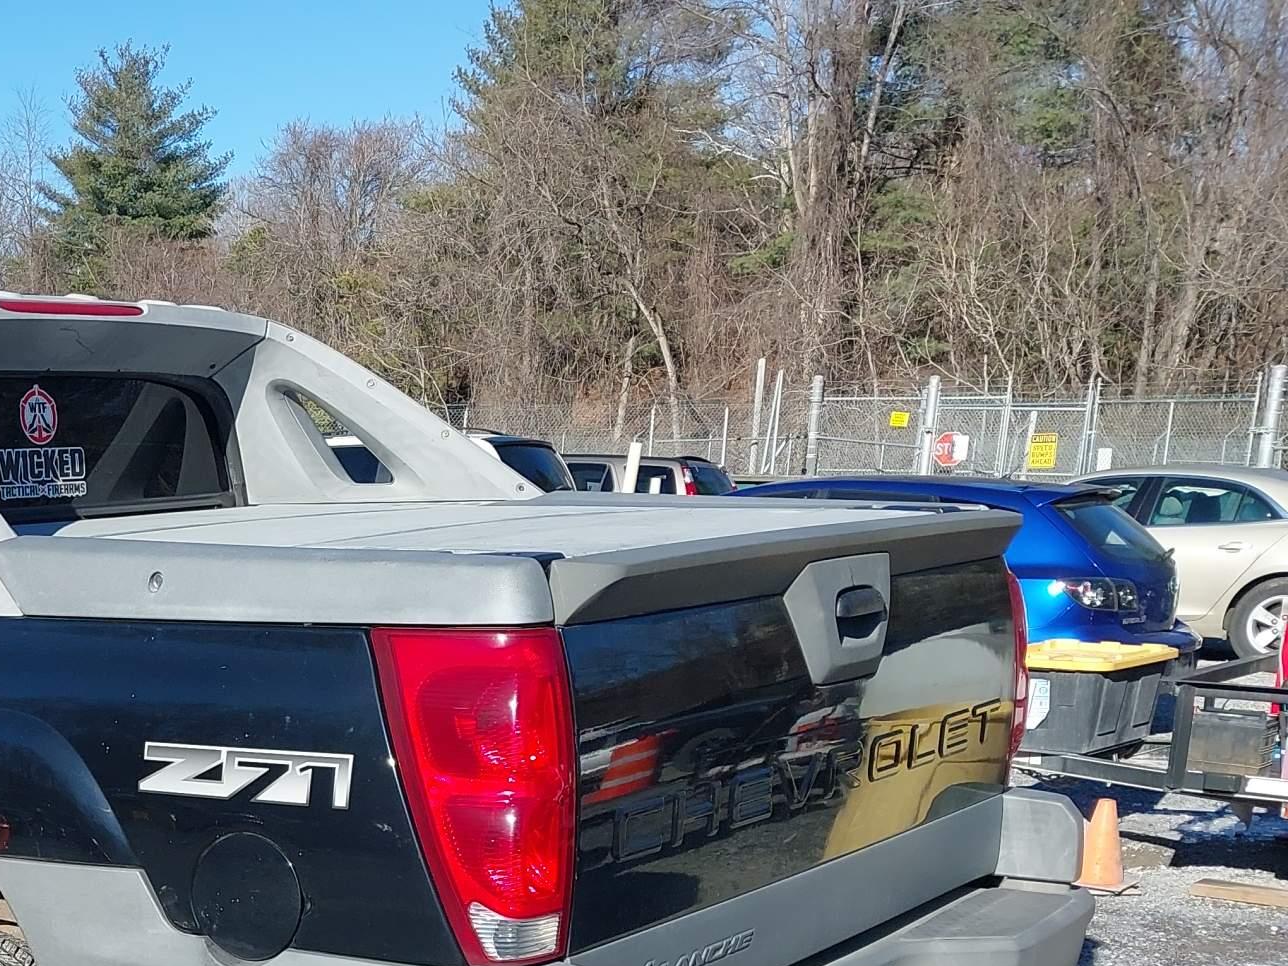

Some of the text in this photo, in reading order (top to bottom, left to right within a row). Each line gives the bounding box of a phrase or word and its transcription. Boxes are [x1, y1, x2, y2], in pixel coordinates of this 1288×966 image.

[28, 402, 48, 414] WTF
[0, 481, 87, 500] TACTICAL FIREARMS
[137, 741, 355, 810] Z71
[614, 697, 1002, 862] CHEVROLET
